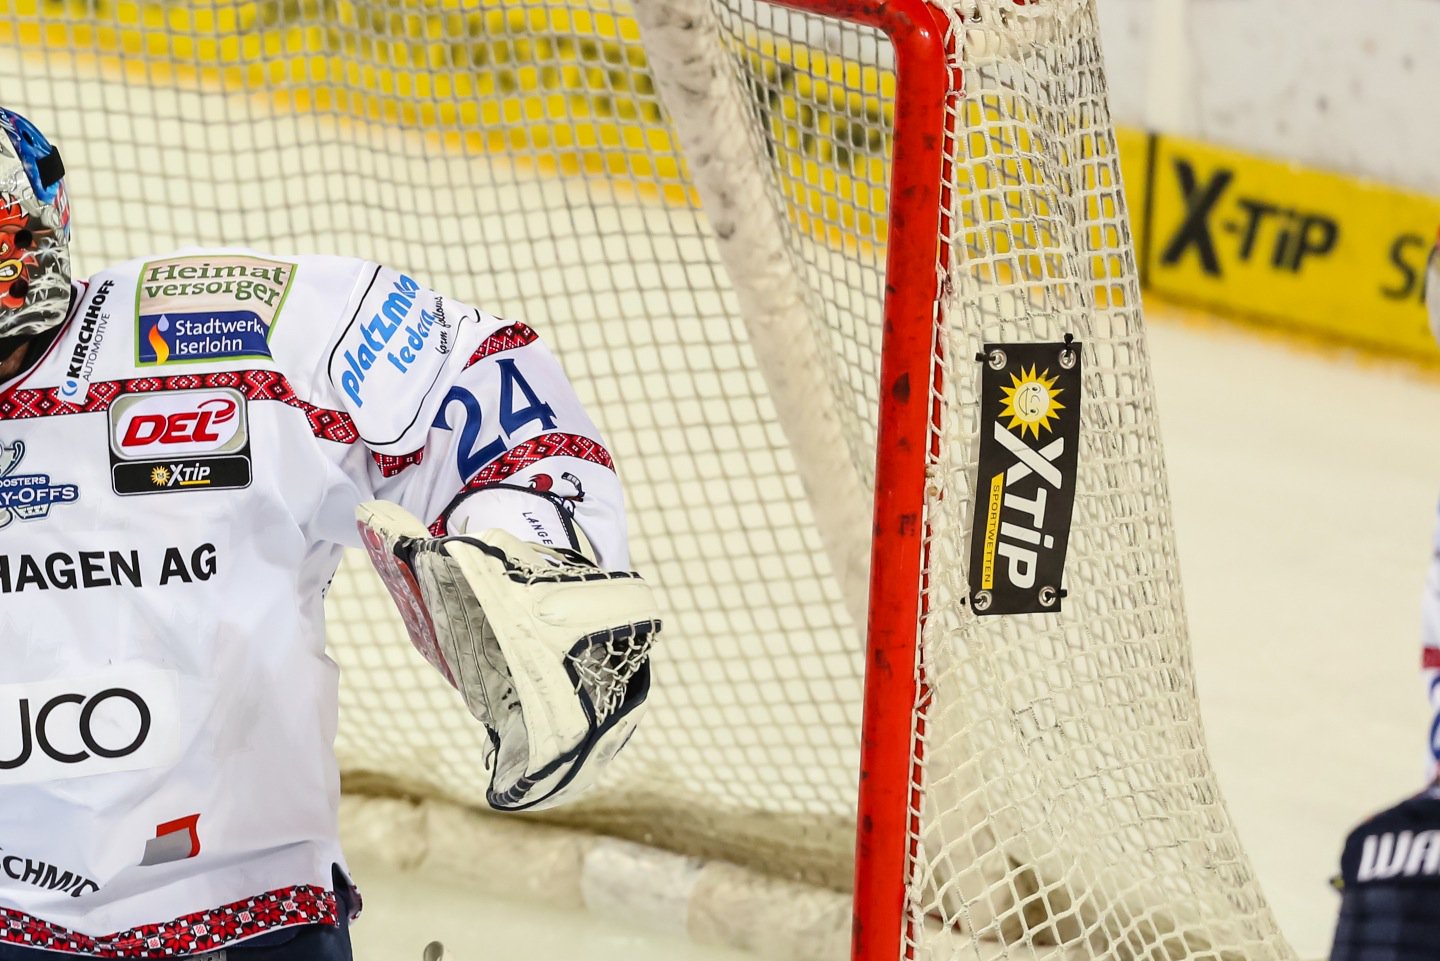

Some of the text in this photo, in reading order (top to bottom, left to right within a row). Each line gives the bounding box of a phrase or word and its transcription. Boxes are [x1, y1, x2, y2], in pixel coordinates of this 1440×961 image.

[145, 280, 281, 308] versorger
[146, 263, 287, 286] Heimat
[66, 279, 115, 379] KIRCHHOFF
[83, 312, 111, 382] AUTOMOTIVE
[176, 337, 242, 355] Iserlohn
[122, 402, 231, 447] DEL
[432, 358, 558, 486] 24
[522, 512, 554, 545] LANGE
[984, 484, 1001, 583] SPORTWETTEN
[159, 543, 218, 586] AG
